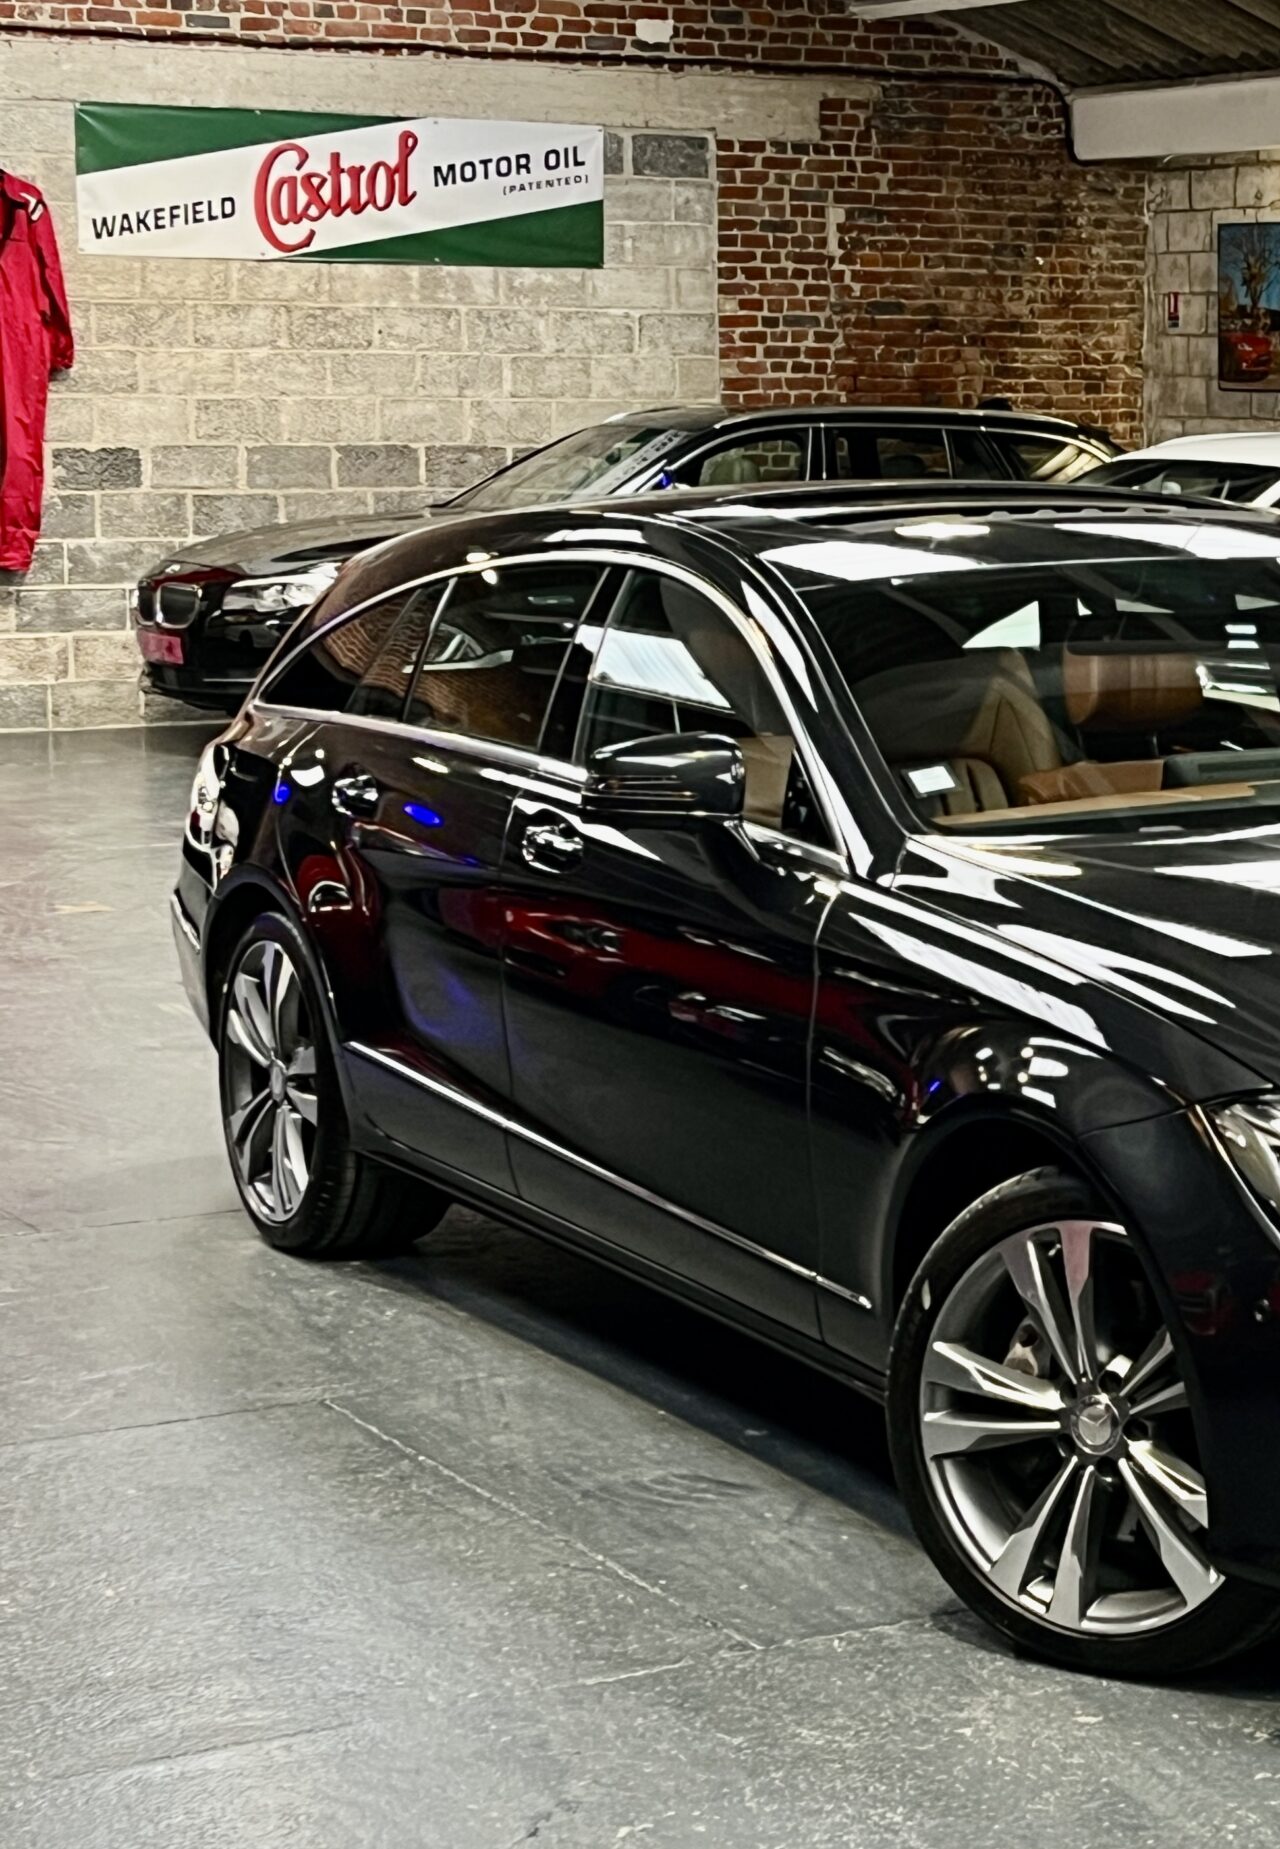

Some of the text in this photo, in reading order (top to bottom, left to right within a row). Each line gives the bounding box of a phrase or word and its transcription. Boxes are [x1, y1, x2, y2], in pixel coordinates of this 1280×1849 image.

[91, 129, 587, 253] WAKEFIELD Castrol MOTOR OIL
[502, 173, 589, 196] (PATENTED)
